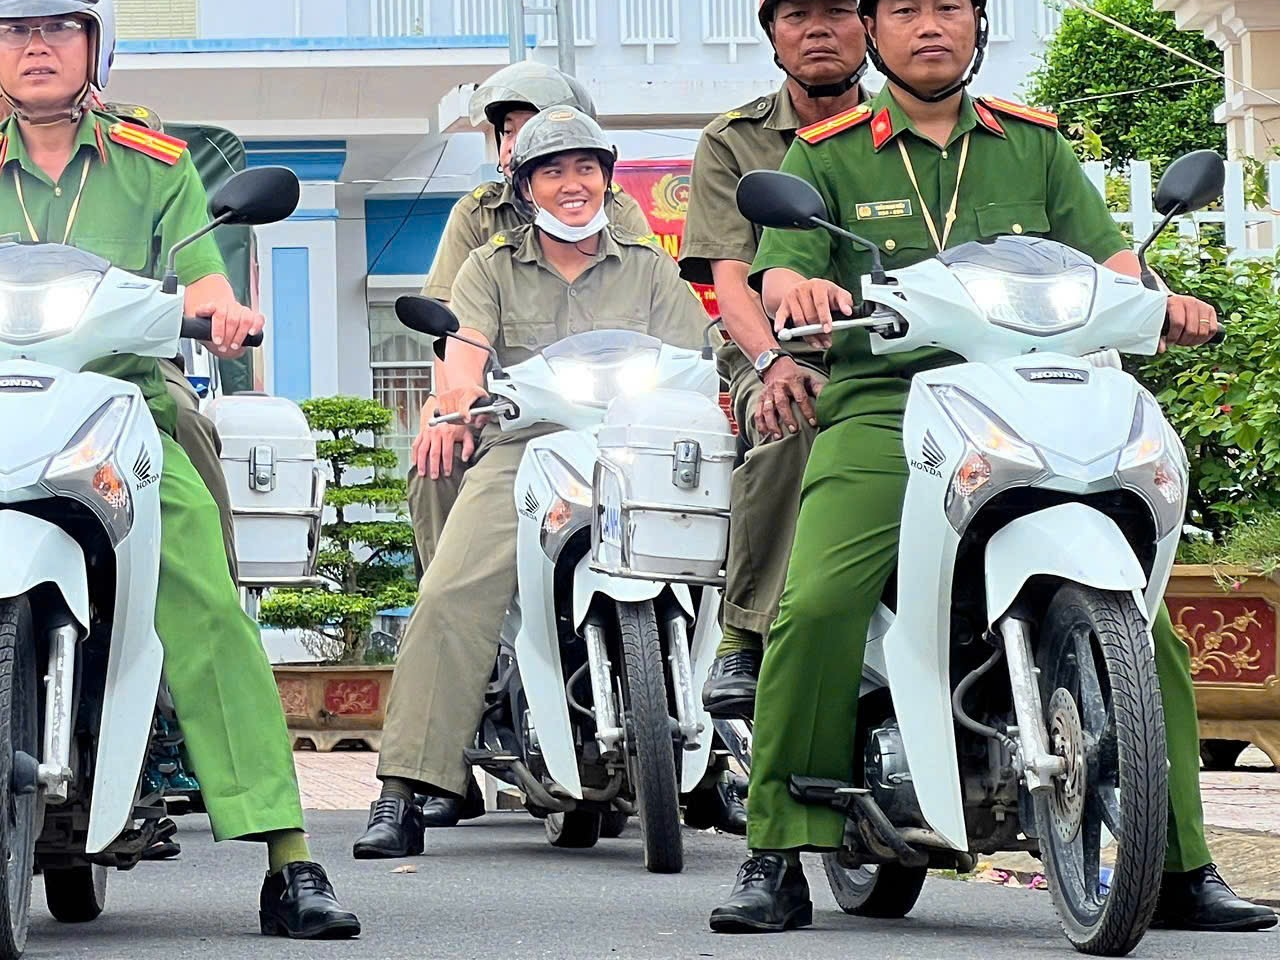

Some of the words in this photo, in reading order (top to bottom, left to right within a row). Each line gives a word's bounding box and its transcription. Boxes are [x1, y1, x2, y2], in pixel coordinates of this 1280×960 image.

[1030, 370, 1084, 381] HONDA
[910, 459, 943, 479] HONDA
[136, 473, 160, 491] HONDA
